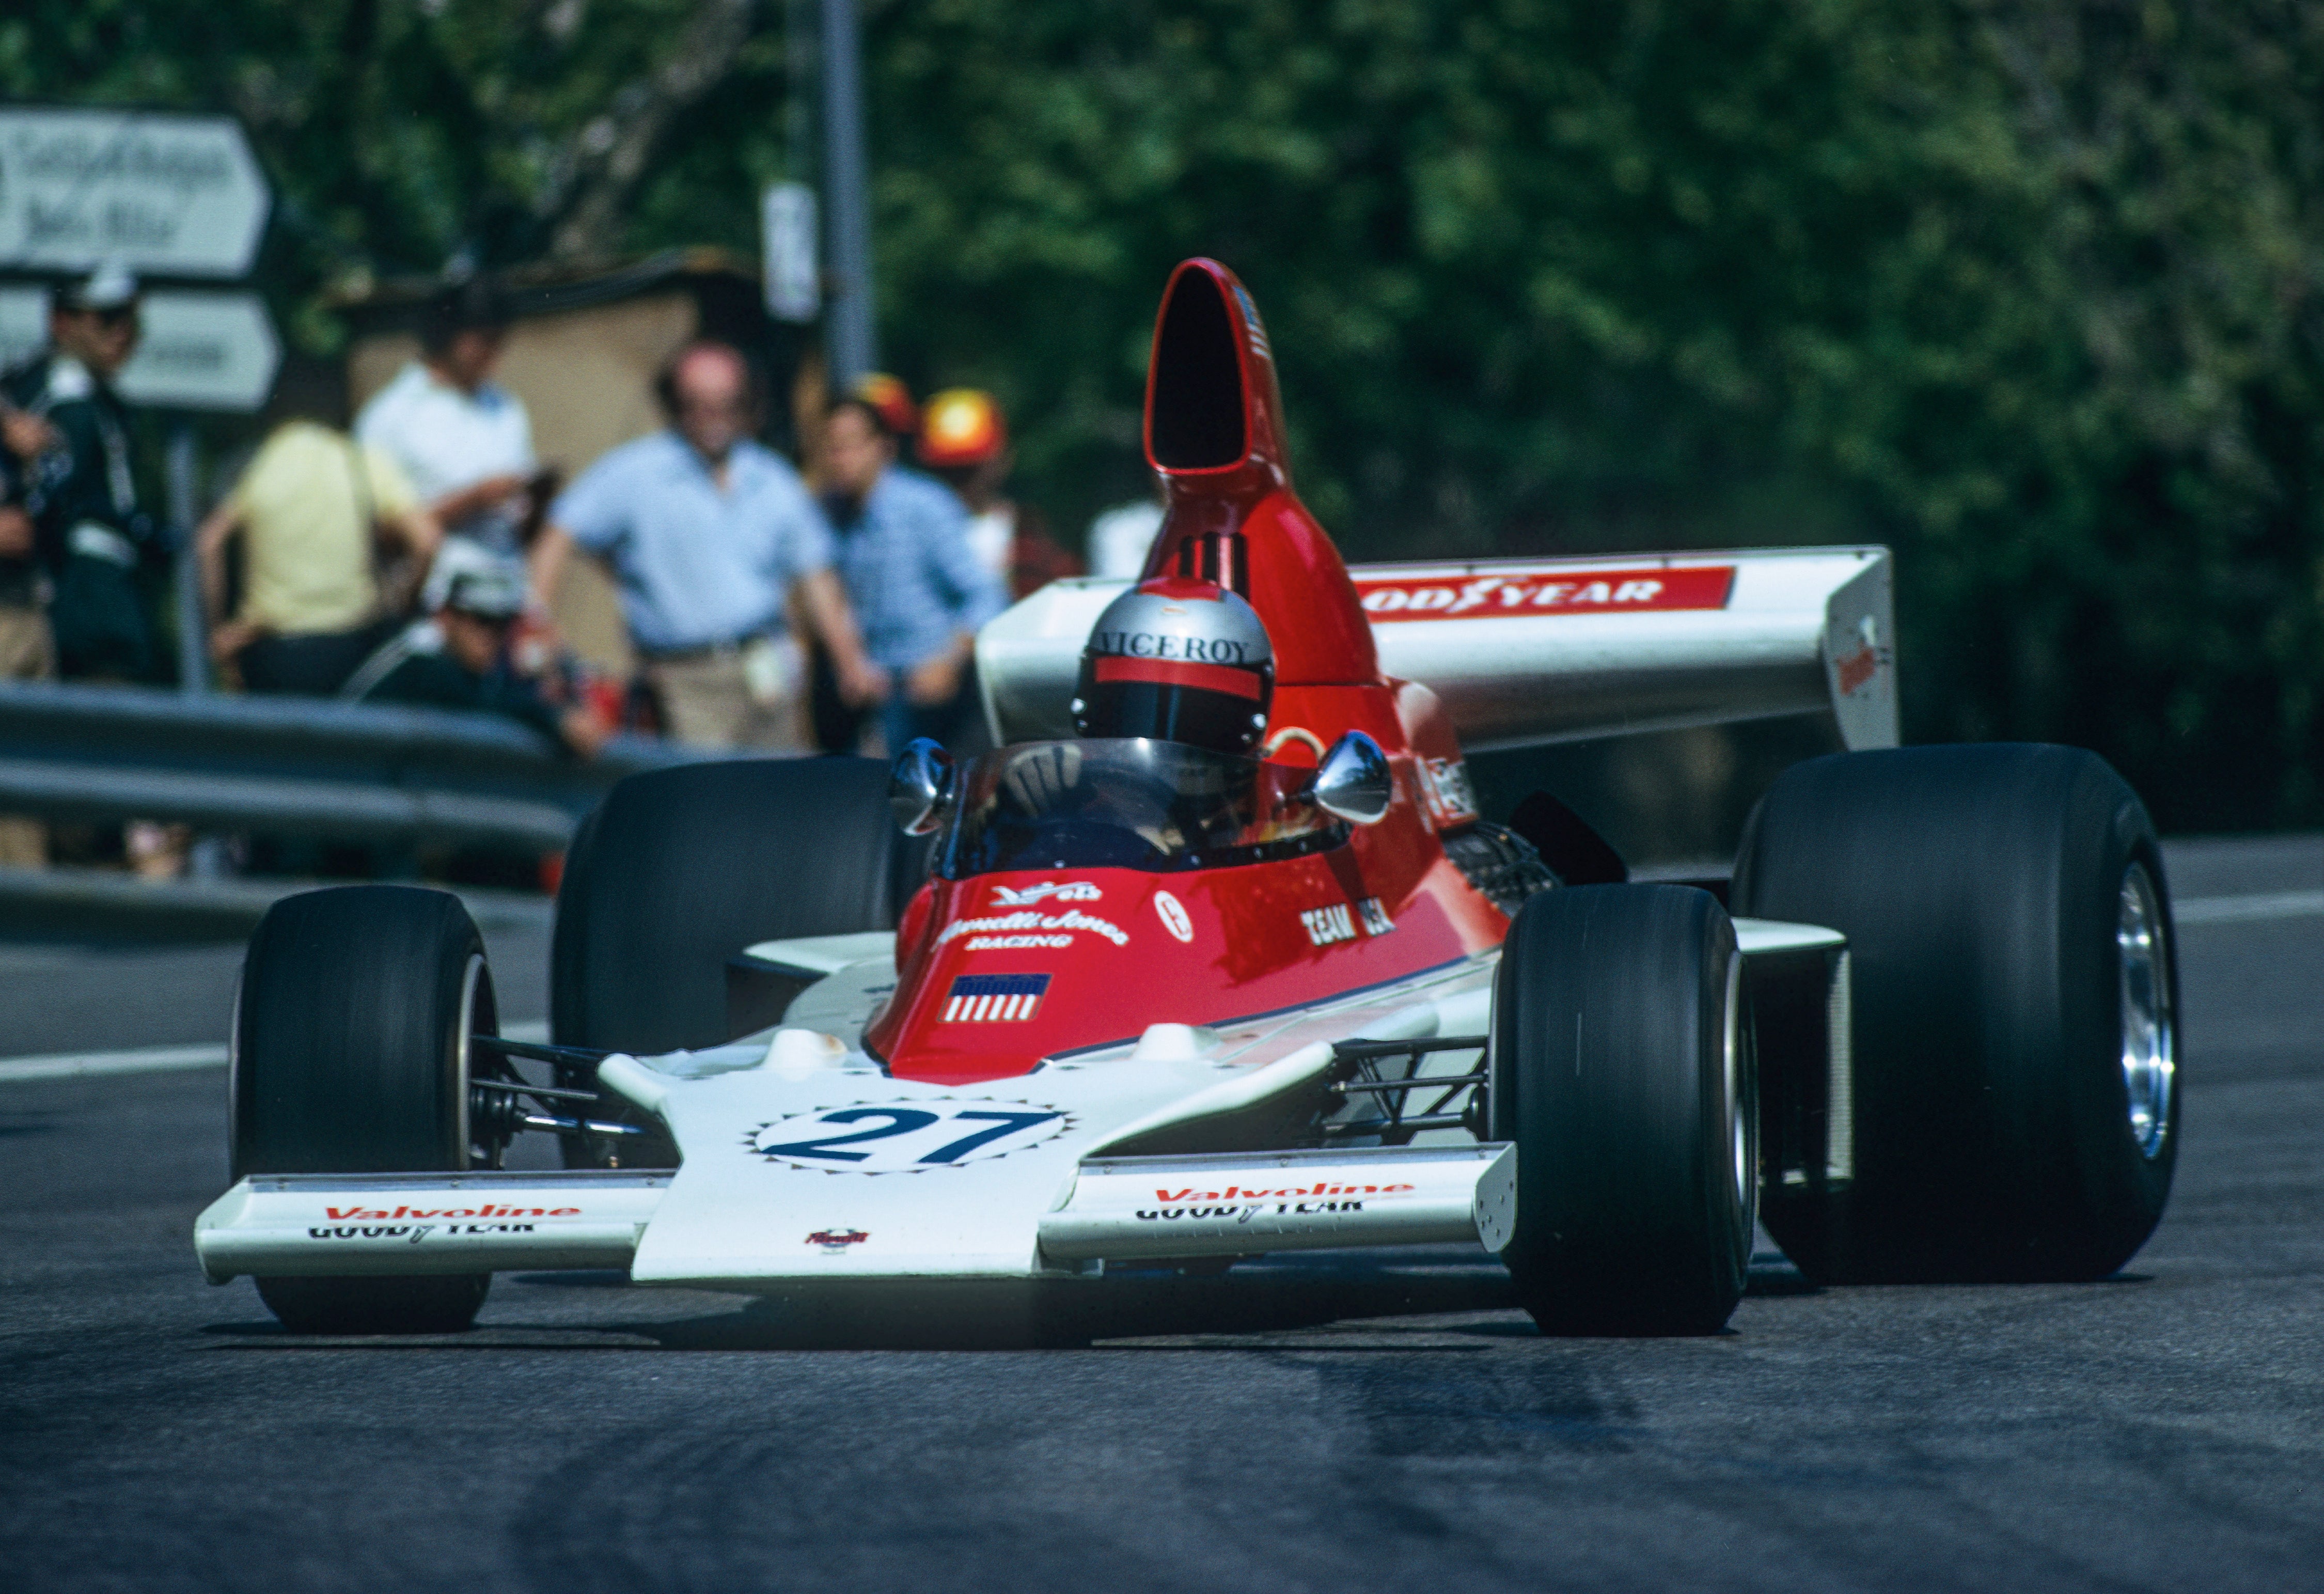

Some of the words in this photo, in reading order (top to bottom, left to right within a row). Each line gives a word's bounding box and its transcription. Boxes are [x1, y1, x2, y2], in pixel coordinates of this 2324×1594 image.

[1361, 578, 1664, 613] ODYEAR
[1101, 631, 1249, 663] VICEROY
[1299, 903, 1357, 946] TEAM
[963, 933, 1074, 951] RACING
[758, 1107, 1068, 1164] 27
[1155, 1182, 1416, 1202] Valvoline
[325, 1204, 582, 1220] Valvoline
